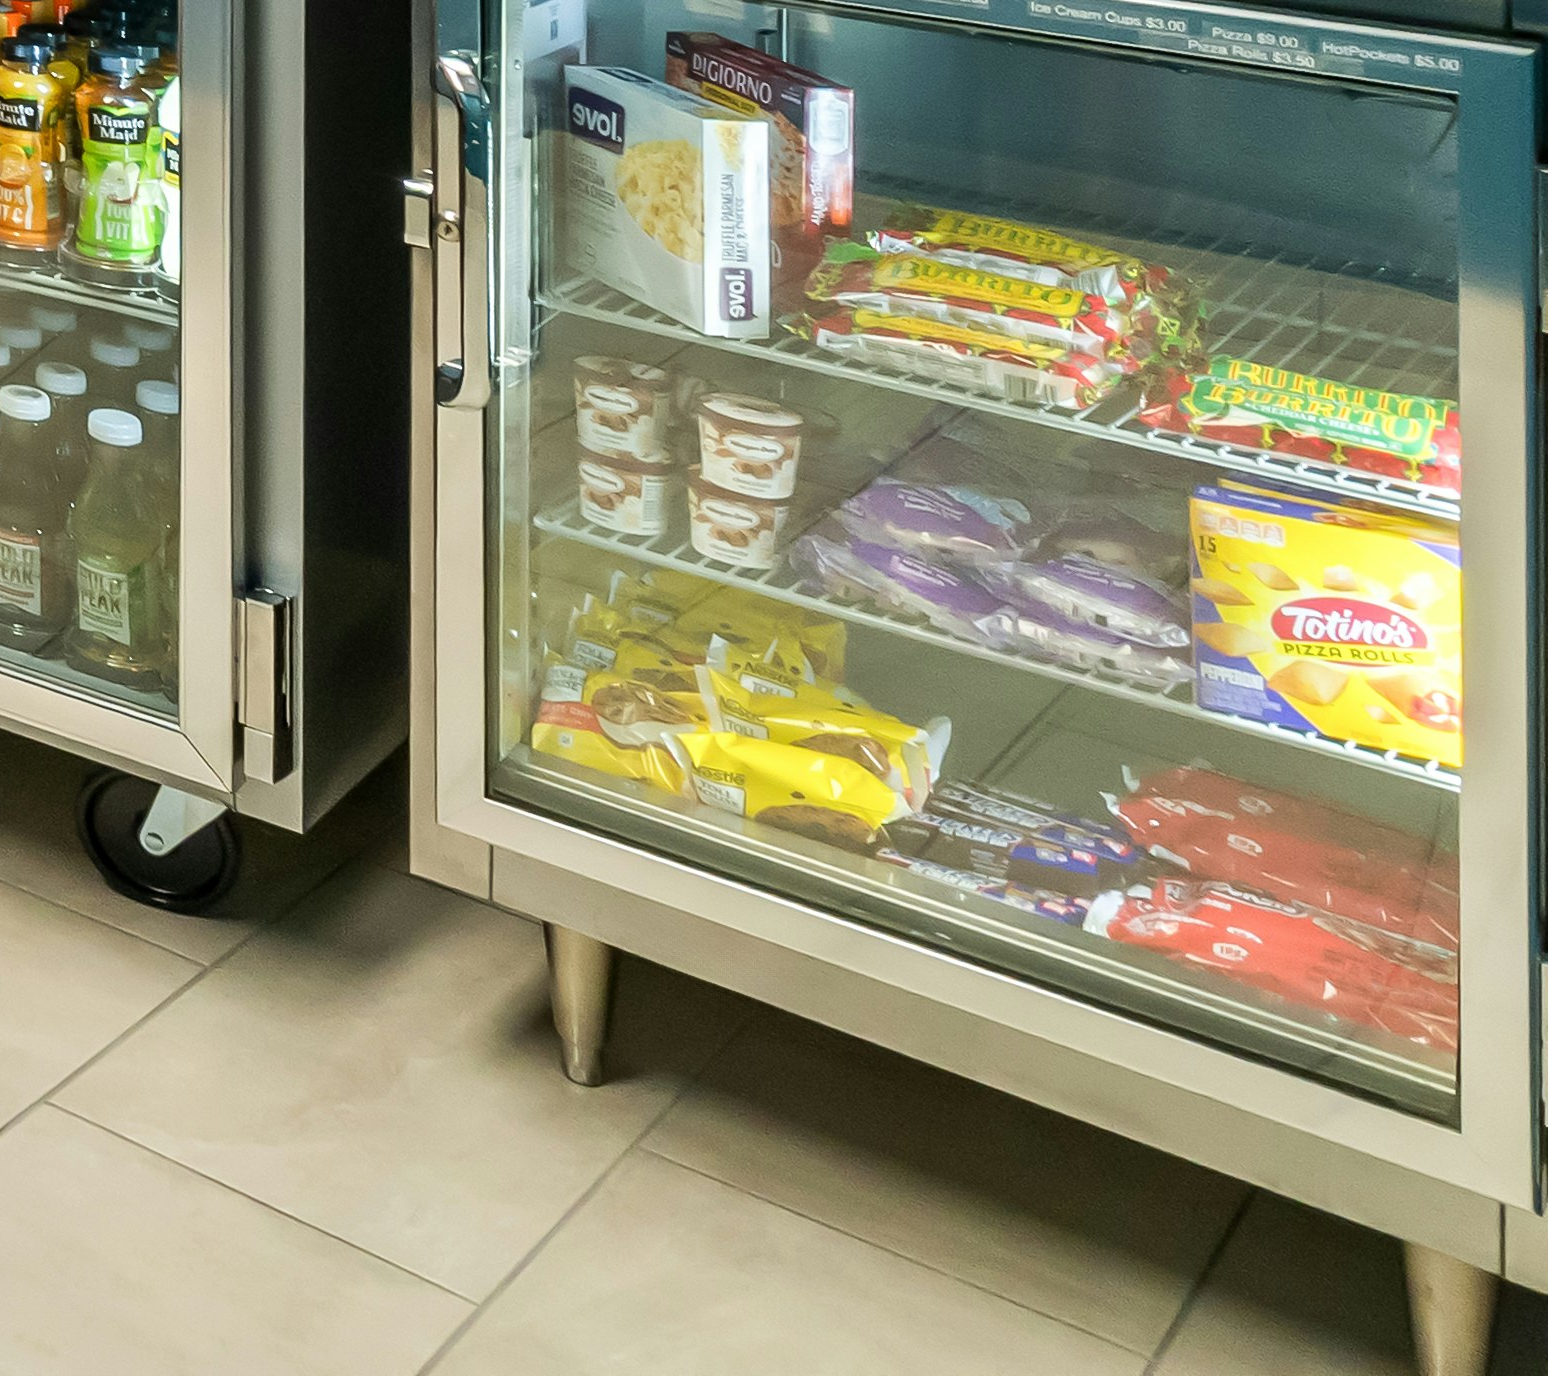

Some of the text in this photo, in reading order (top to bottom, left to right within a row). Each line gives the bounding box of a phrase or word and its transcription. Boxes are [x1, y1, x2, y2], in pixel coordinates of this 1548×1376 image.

[1031, 1, 1186, 34] Ice Cream Cups $3.00
[1187, 39, 1315, 68] Pizza Rolls $3.50
[1212, 27, 1299, 49] Pizza $9.00
[1322, 40, 1459, 73] HotPockets $5.00
[692, 53, 772, 105] DIGIORNO
[571, 104, 622, 144] evol.
[1281, 605, 1412, 646] Totino's
[1282, 643, 1414, 664] PIZZA ROLLS
